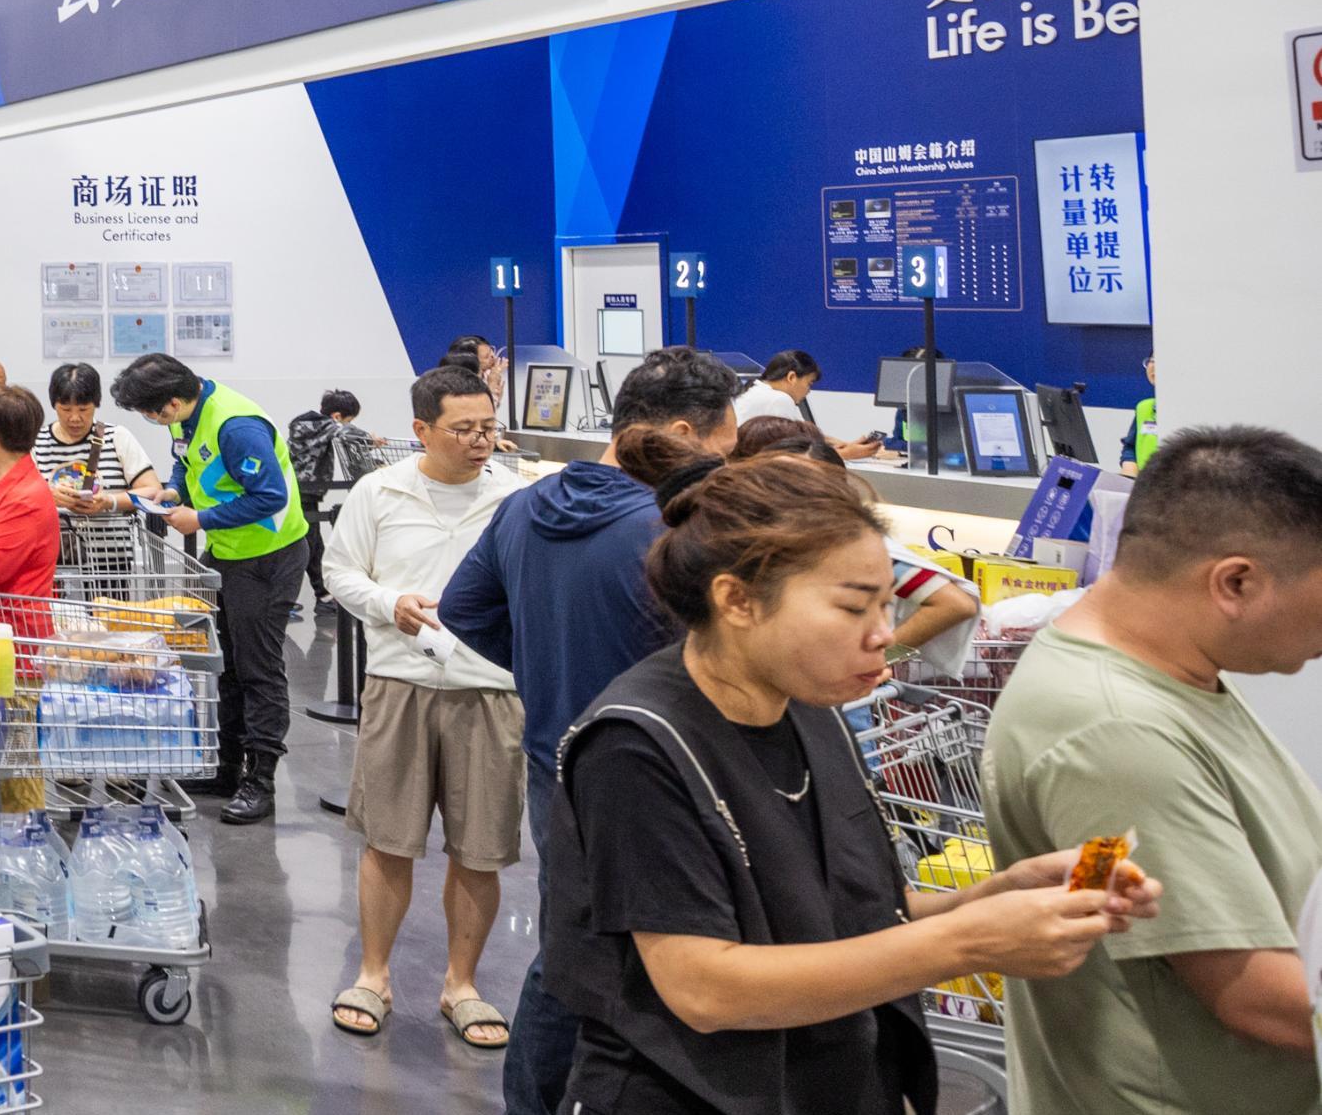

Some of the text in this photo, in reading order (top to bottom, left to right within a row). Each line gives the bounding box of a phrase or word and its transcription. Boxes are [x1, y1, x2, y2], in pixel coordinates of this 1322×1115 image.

[926, 8, 1007, 60] Life
[1020, 1, 1057, 46] is
[855, 160, 974, 177] China Sam's Membership Values
[71, 174, 199, 208] 商场证照
[74, 211, 199, 226] Business License and
[102, 228, 172, 243] Certificates
[495, 265, 506, 290] 1
[676, 260, 690, 289] 2
[910, 255, 926, 287] 3
